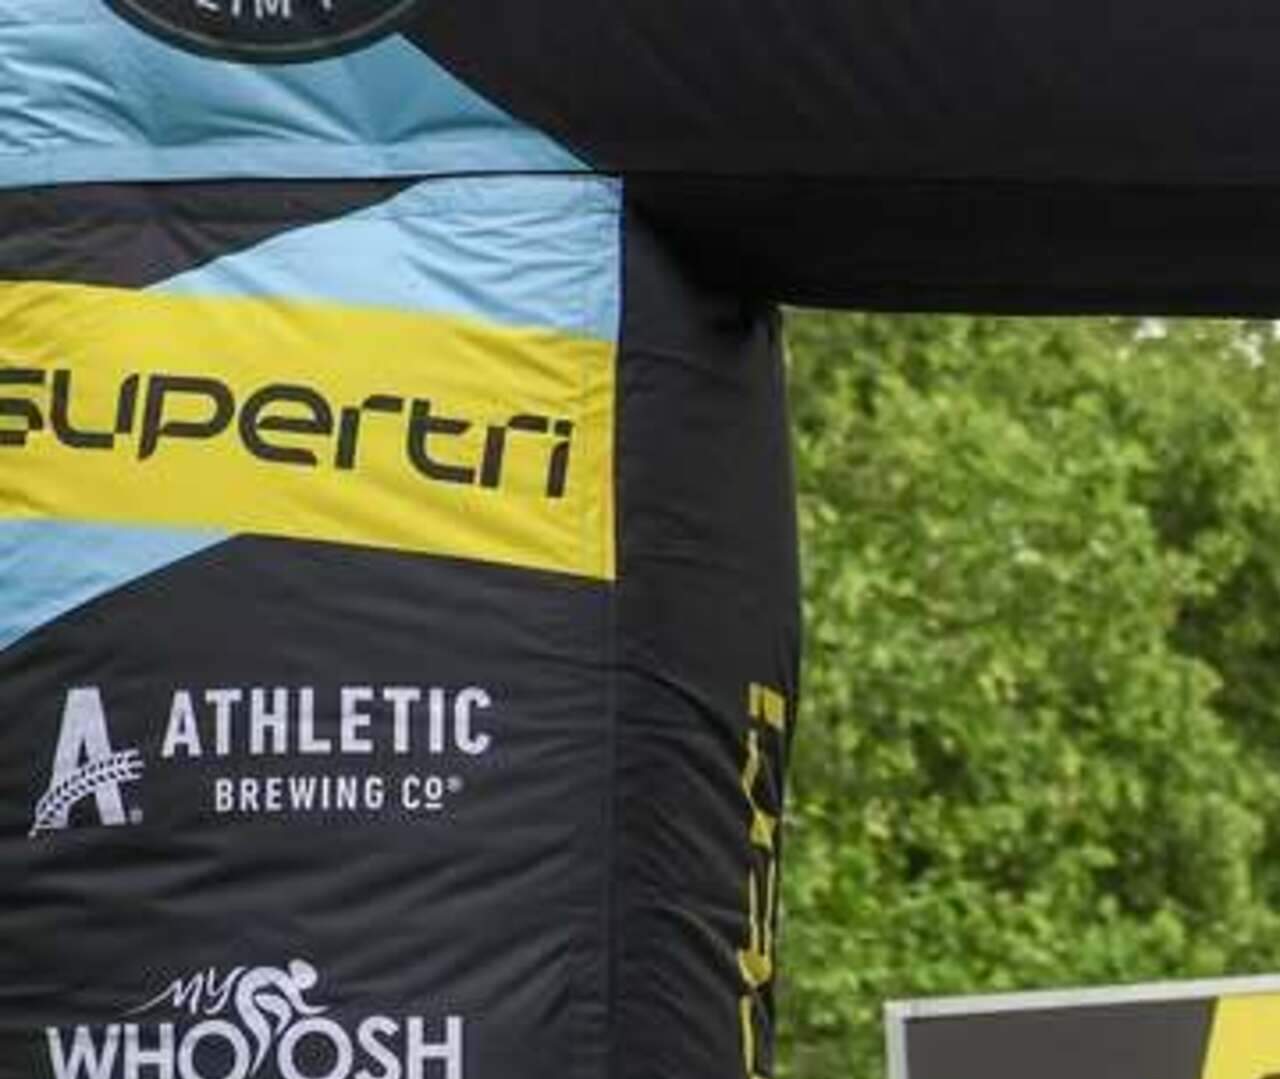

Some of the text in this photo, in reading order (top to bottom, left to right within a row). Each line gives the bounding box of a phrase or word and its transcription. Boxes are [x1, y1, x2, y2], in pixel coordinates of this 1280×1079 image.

[0, 368, 573, 498] supertri
[161, 686, 491, 758] ATHLETIC
[215, 777, 385, 812] BREWING
